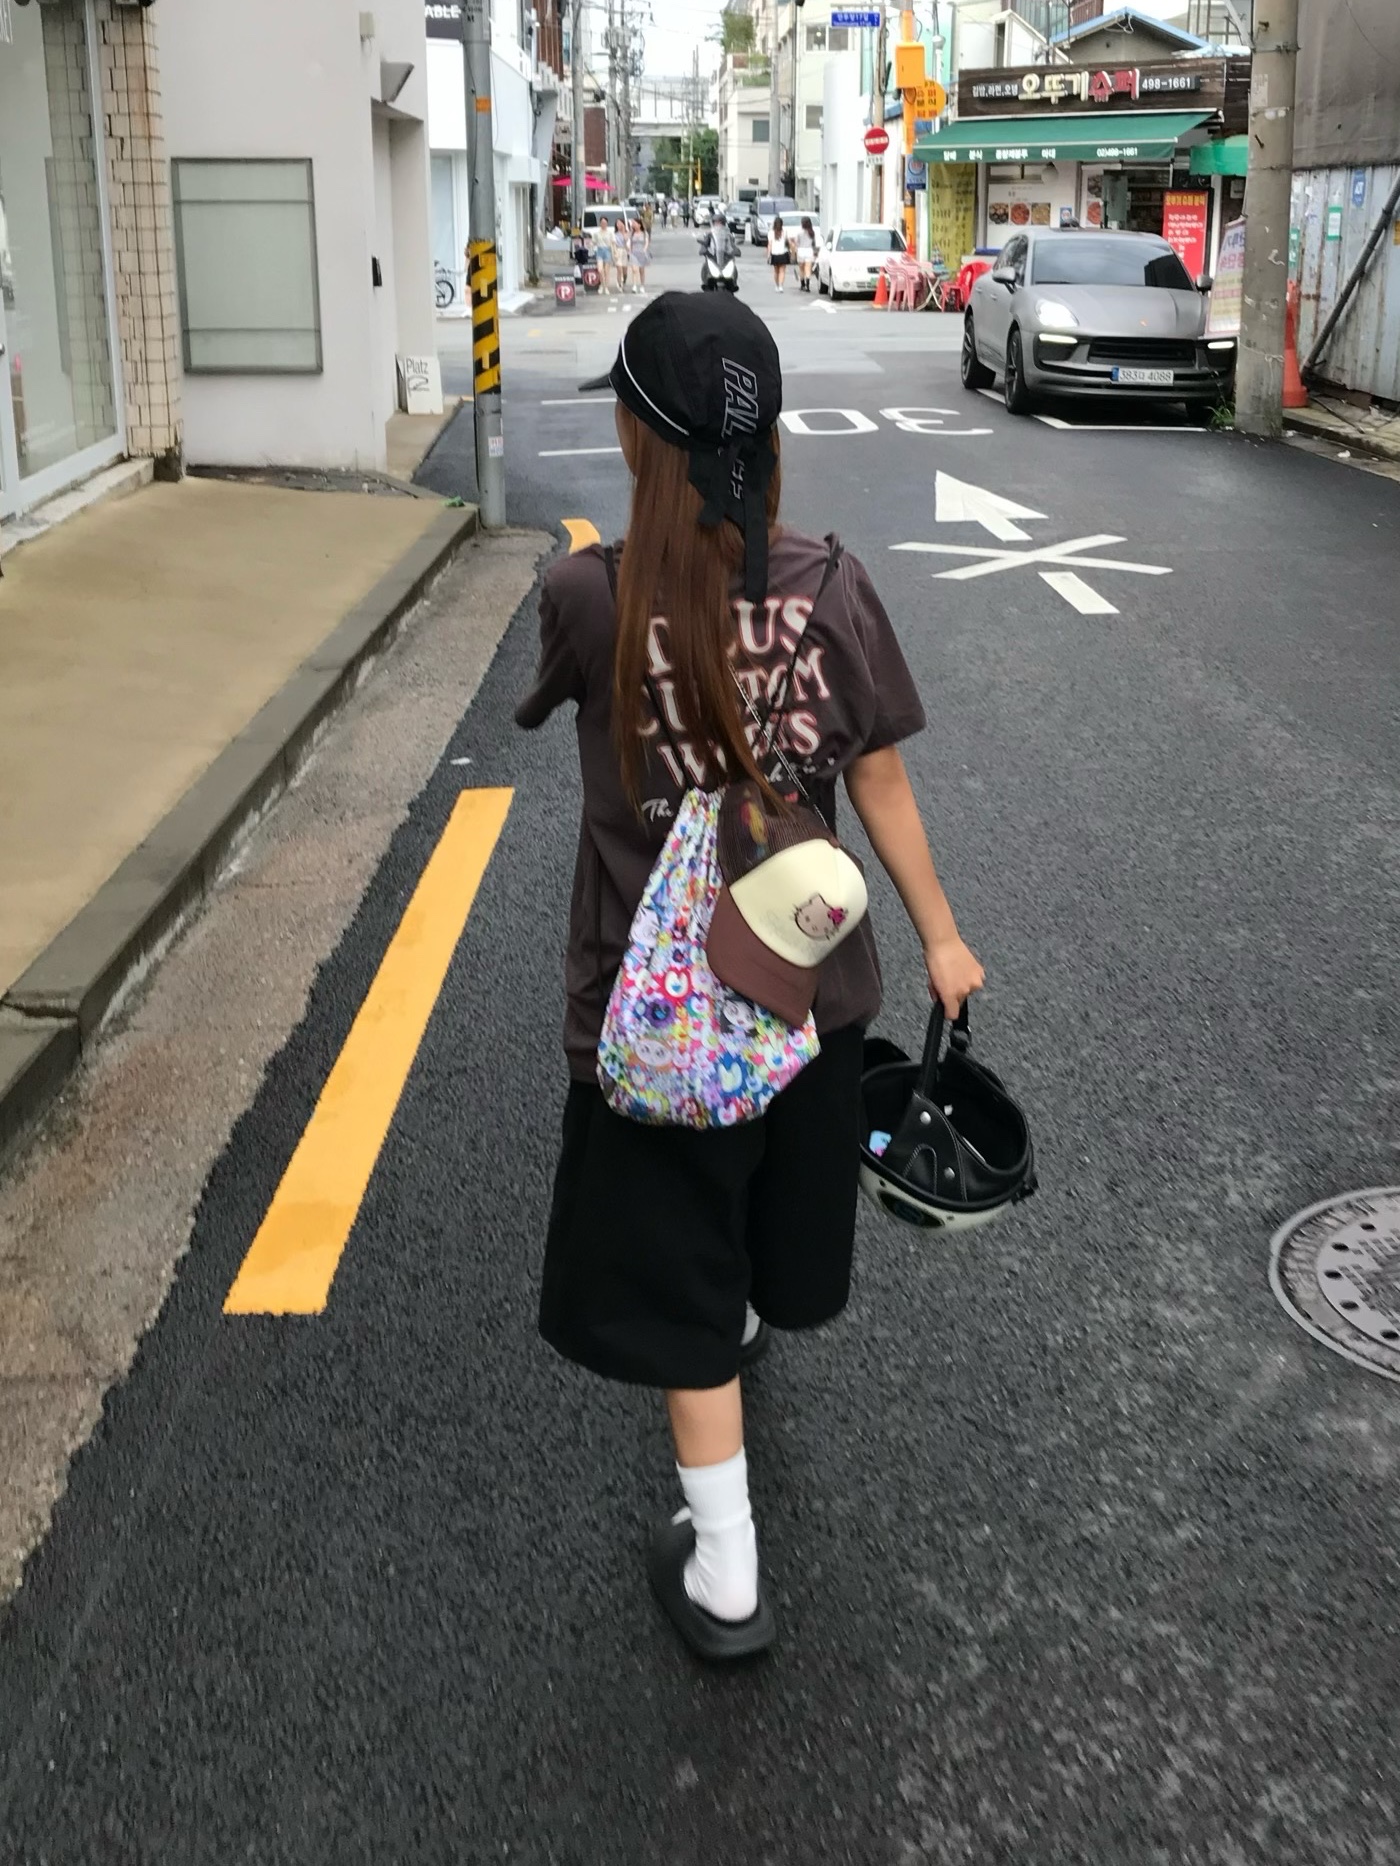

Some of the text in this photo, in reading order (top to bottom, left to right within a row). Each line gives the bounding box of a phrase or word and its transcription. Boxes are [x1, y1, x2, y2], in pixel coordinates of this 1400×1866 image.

[1142, 77, 1191, 90] 498-1661
[406, 358, 429, 375] Platz
[1148, 370, 1172, 382] 4088
